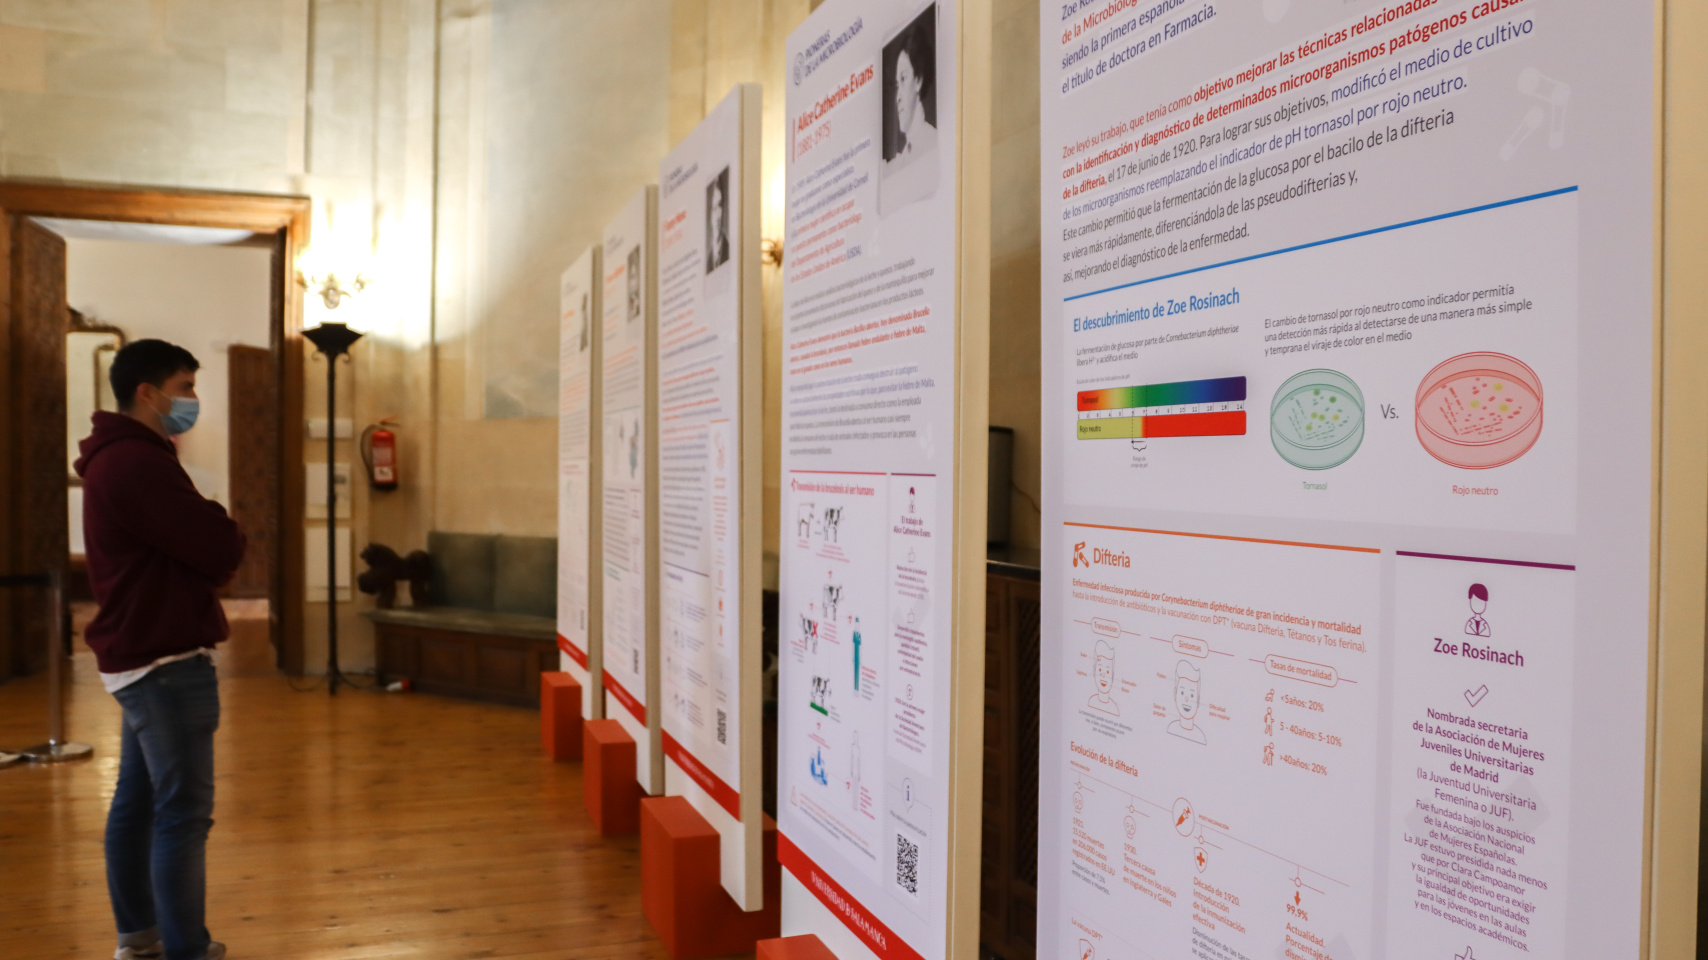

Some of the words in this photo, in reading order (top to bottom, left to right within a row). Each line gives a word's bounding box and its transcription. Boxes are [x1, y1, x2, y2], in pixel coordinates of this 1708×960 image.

[1061, 44, 1089, 69] siendo
[1091, 38, 1098, 52] la
[1100, 19, 1139, 50] primera
[1062, 78, 1069, 93] el
[1071, 68, 1093, 88] título
[1095, 60, 1107, 76] de
[1109, 41, 1145, 68] doctora
[1148, 33, 1161, 48] en
[1164, 4, 1216, 40] Farmacia.
[798, 111, 814, 132] Alice
[815, 84, 849, 120] Catherine
[850, 64, 874, 93] Evans
[1062, 146, 1075, 158] Zoe
[1076, 139, 1090, 152] leyó
[1091, 136, 1099, 146] su
[1100, 122, 1128, 142] trabajo,
[1129, 116, 1144, 130] que
[1145, 104, 1166, 122] tenía
[1167, 95, 1192, 112] como
[1193, 78, 1233, 102] objetivo
[1236, 58, 1277, 84] mejorar
[1279, 51, 1295, 66] las
[1297, 29, 1347, 58] técnicas
[1062, 167, 1074, 178] con
[1076, 163, 1082, 173] la
[1083, 143, 1133, 170] identificación
[1134, 140, 1139, 152] y
[1140, 120, 1190, 147] diagnóstico
[1192, 112, 1204, 127] de
[1206, 86, 1277, 121] determinados
[1279, 43, 1385, 93] microorganismos
[1389, 11, 1467, 55] patógenos
[1062, 188, 1071, 199] de
[1072, 185, 1078, 196] la
[1079, 175, 1107, 193] difteria,
[1107, 169, 1114, 182] el
[1116, 165, 1126, 179] 17
[1127, 162, 1137, 175] de
[1138, 154, 1158, 174] junio
[1159, 150, 1170, 163] de
[1172, 139, 1197, 158] 1920.
[1199, 133, 1220, 149] Para
[1222, 121, 1252, 140] lograr
[1254, 114, 1271, 129] sus
[1273, 94, 1328, 122] objetivos,
[1331, 68, 1386, 102] modificó
[1389, 62, 1400, 81] el
[1404, 48, 1450, 76] medio
[1453, 39, 1472, 58] de
[1476, 20, 1533, 50] cultivo
[1062, 209, 1071, 220] de
[1072, 206, 1081, 216] los
[1082, 184, 1144, 212] microorganismos
[1146, 161, 1207, 191] reemplazando
[1208, 155, 1217, 170] el
[1219, 142, 1267, 166] indicador
[1268, 135, 1282, 150] de
[1285, 127, 1301, 148] pH
[1303, 108, 1353, 139] tornasol
[1357, 104, 1379, 125] por
[1382, 92, 1409, 114] rojo
[1413, 77, 1466, 104] neutro.
[1073, 318, 1080, 332] El
[1082, 307, 1150, 330] descubrimiento
[1152, 302, 1164, 318] de
[1166, 300, 1186, 315] Zoe
[1189, 288, 1239, 311] Rosinach
[1264, 319, 1271, 328] El
[1272, 316, 1296, 327] cambio
[1297, 314, 1306, 324] de
[1307, 309, 1338, 322] tornasol
[1339, 309, 1353, 320] por
[1354, 305, 1370, 317] rojo
[1372, 303, 1400, 313] neutro
[1401, 299, 1425, 309] como
[1426, 291, 1470, 305] indicador
[1472, 284, 1514, 302] permitía
[1277, 328, 1311, 340] detección
[1312, 326, 1327, 335] más
[1328, 322, 1352, 334] rápida
[1354, 321, 1361, 330] al
[1362, 317, 1406, 329] detectarse
[1408, 314, 1419, 324] de
[1420, 313, 1437, 322] una
[1439, 309, 1474, 320] manera
[1476, 304, 1496, 315] más
[1498, 299, 1532, 313] simple
[1381, 404, 1399, 419] Vs.
[1302, 481, 1327, 490] Tornasol
[1452, 485, 1470, 496] Rojo
[1093, 548, 1130, 568] Difteria
[1270, 660, 1286, 670] Tasas
[1286, 664, 1295, 672] de
[1295, 668, 1332, 680] mortalidad
[1433, 638, 1458, 655] Zoe
[1461, 642, 1524, 667] Rosinach
[1412, 721, 1423, 731] de
[1425, 723, 1433, 734] la
[1434, 726, 1485, 746] Asociación
[1487, 738, 1500, 750] de
[1502, 741, 1544, 761] Mujeres
[1426, 708, 1475, 728] Nombrada
[1477, 722, 1528, 740] secretaria
[1070, 741, 1098, 760] Evolución
[1099, 754, 1107, 764] de
[1108, 756, 1113, 767] la
[1114, 760, 1138, 776] difteria
[1420, 738, 1462, 757] Juveniles
[1464, 748, 1534, 775] Universitarias
[1449, 761, 1461, 773] de
[1463, 764, 1498, 783] Madrid
[1416, 768, 1427, 779] (la
[1428, 772, 1470, 792] Juventud
[1472, 783, 1536, 810] Universitaria
[1434, 788, 1478, 810] Femenina
[1488, 804, 1514, 821] JUF).
[1193, 877, 1214, 893] Década
[1215, 888, 1222, 897] de
[1224, 892, 1240, 906] 1920.
[1193, 889, 1229, 913] Introducción
[1286, 904, 1308, 921] 99.9%
[1286, 922, 1325, 948] Actualidad.
